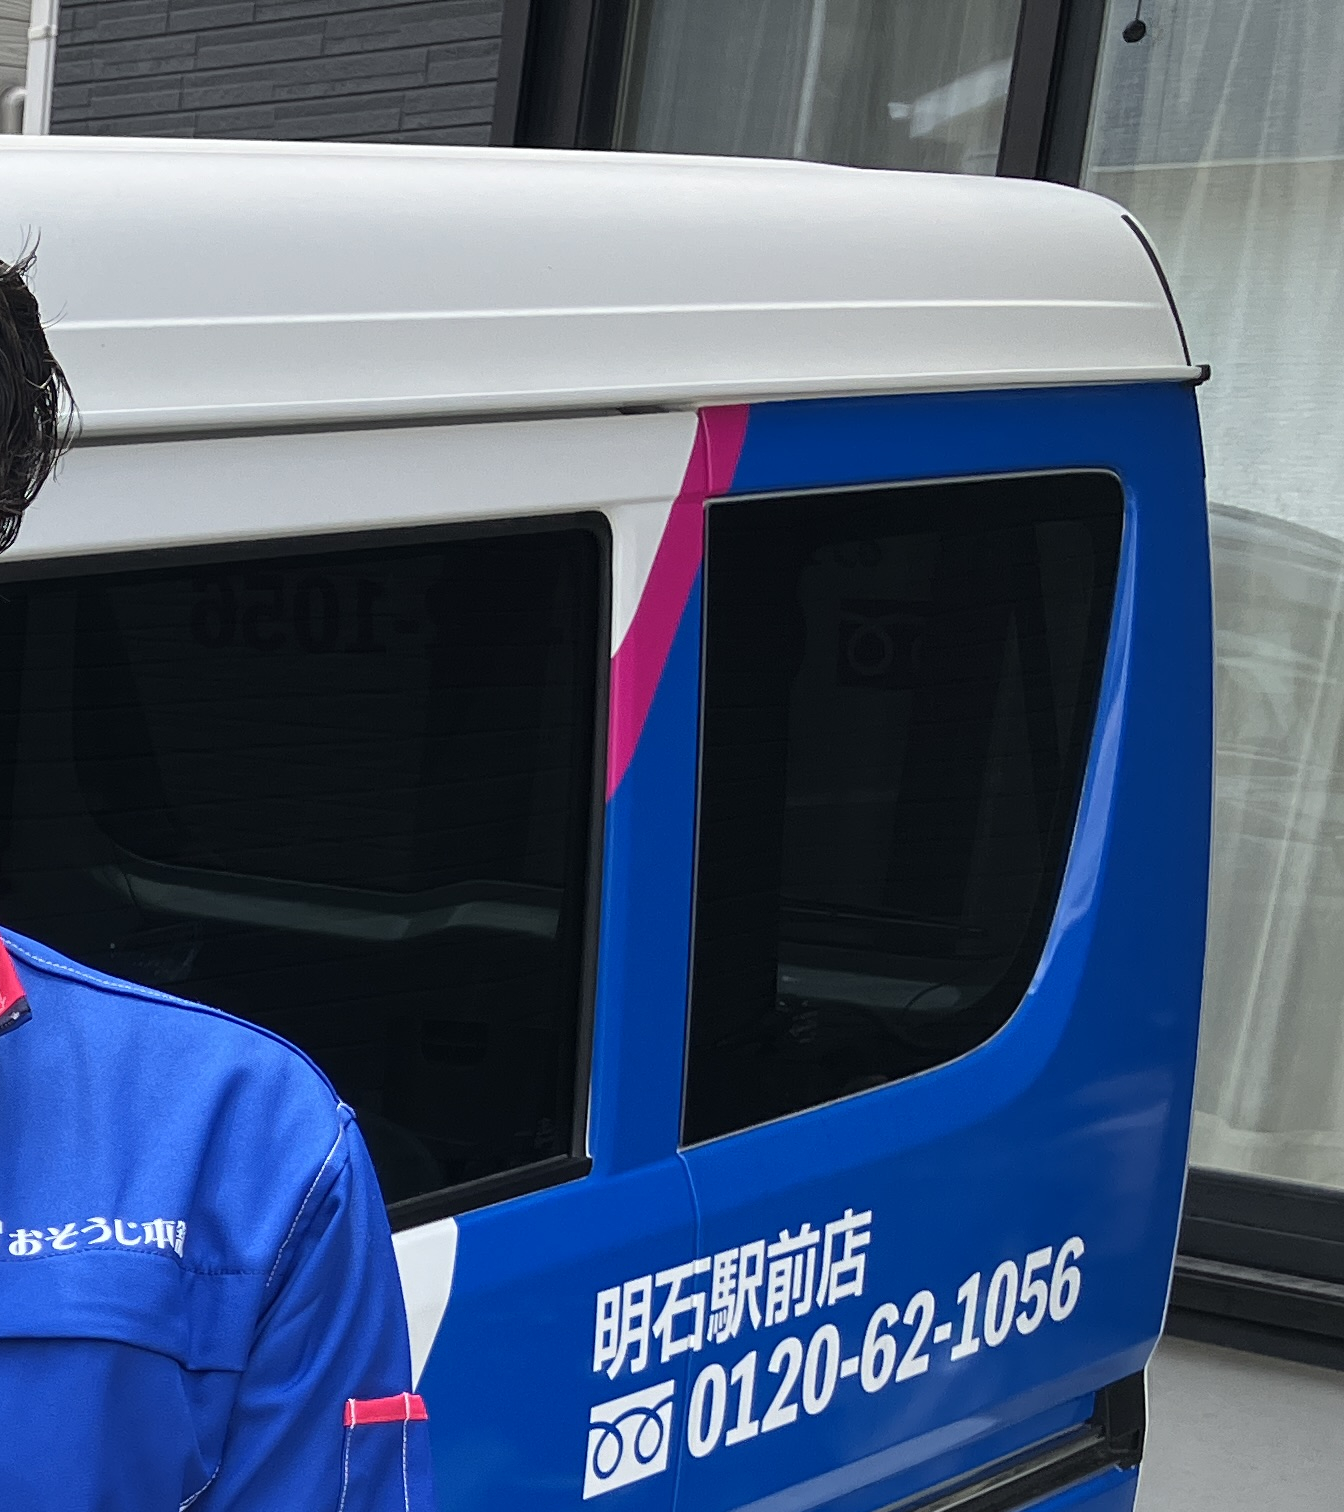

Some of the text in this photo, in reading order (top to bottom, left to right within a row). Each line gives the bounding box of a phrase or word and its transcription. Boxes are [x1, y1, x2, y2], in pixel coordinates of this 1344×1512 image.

[592, 1208, 872, 1380] 明石駅前店
[686, 1236, 1086, 1459] 0120-62-1056
